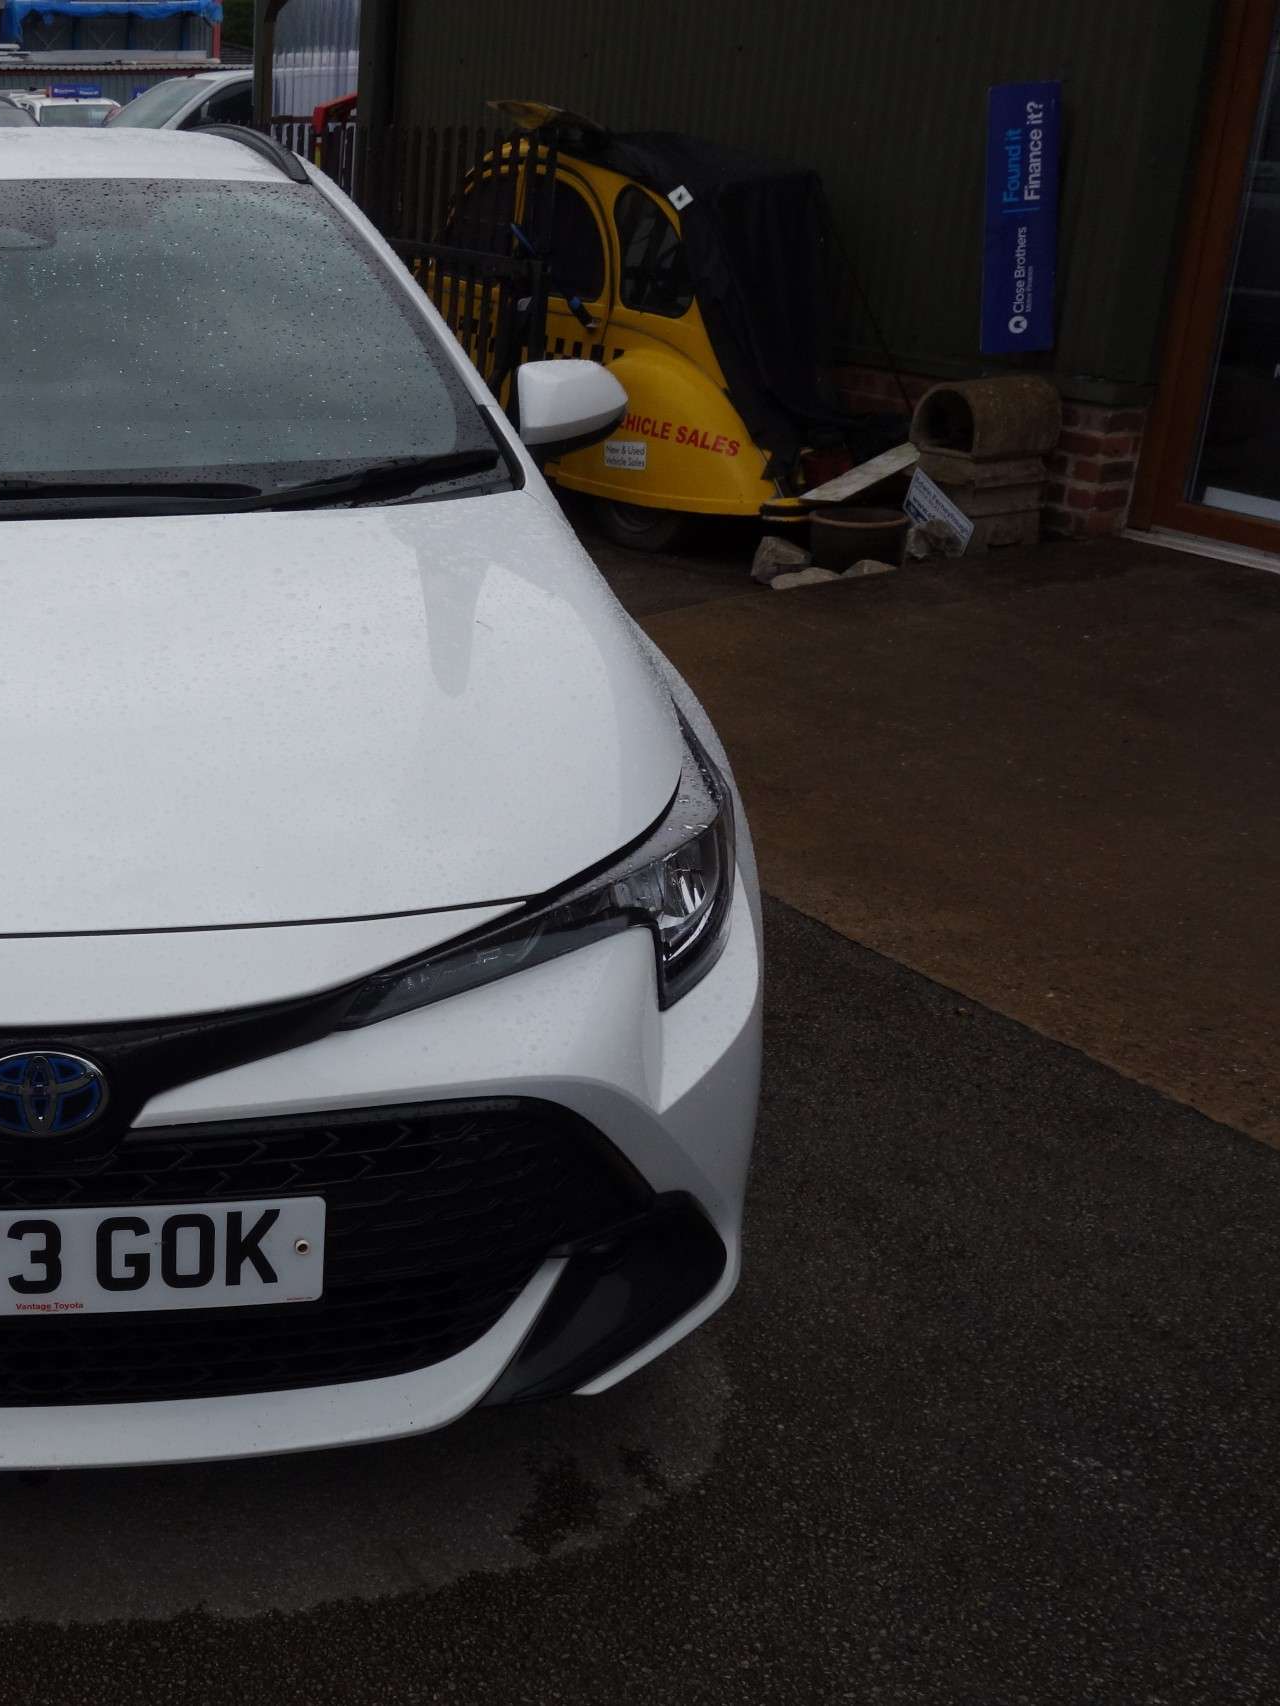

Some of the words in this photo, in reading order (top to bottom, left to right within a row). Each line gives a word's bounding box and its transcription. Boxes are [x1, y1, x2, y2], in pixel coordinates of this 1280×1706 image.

[1026, 101, 1044, 125] it?
[1004, 127, 1022, 141] it
[1002, 143, 1021, 203] Found
[1024, 127, 1042, 201] Finance
[1014, 226, 1027, 279] Brothers
[1012, 280, 1025, 313] Close
[675, 425, 741, 457] SALES
[96, 1209, 280, 1292] GOK
[15, 1303, 51, 1311] Vantage
[54, 1302, 84, 1310] Toyota
